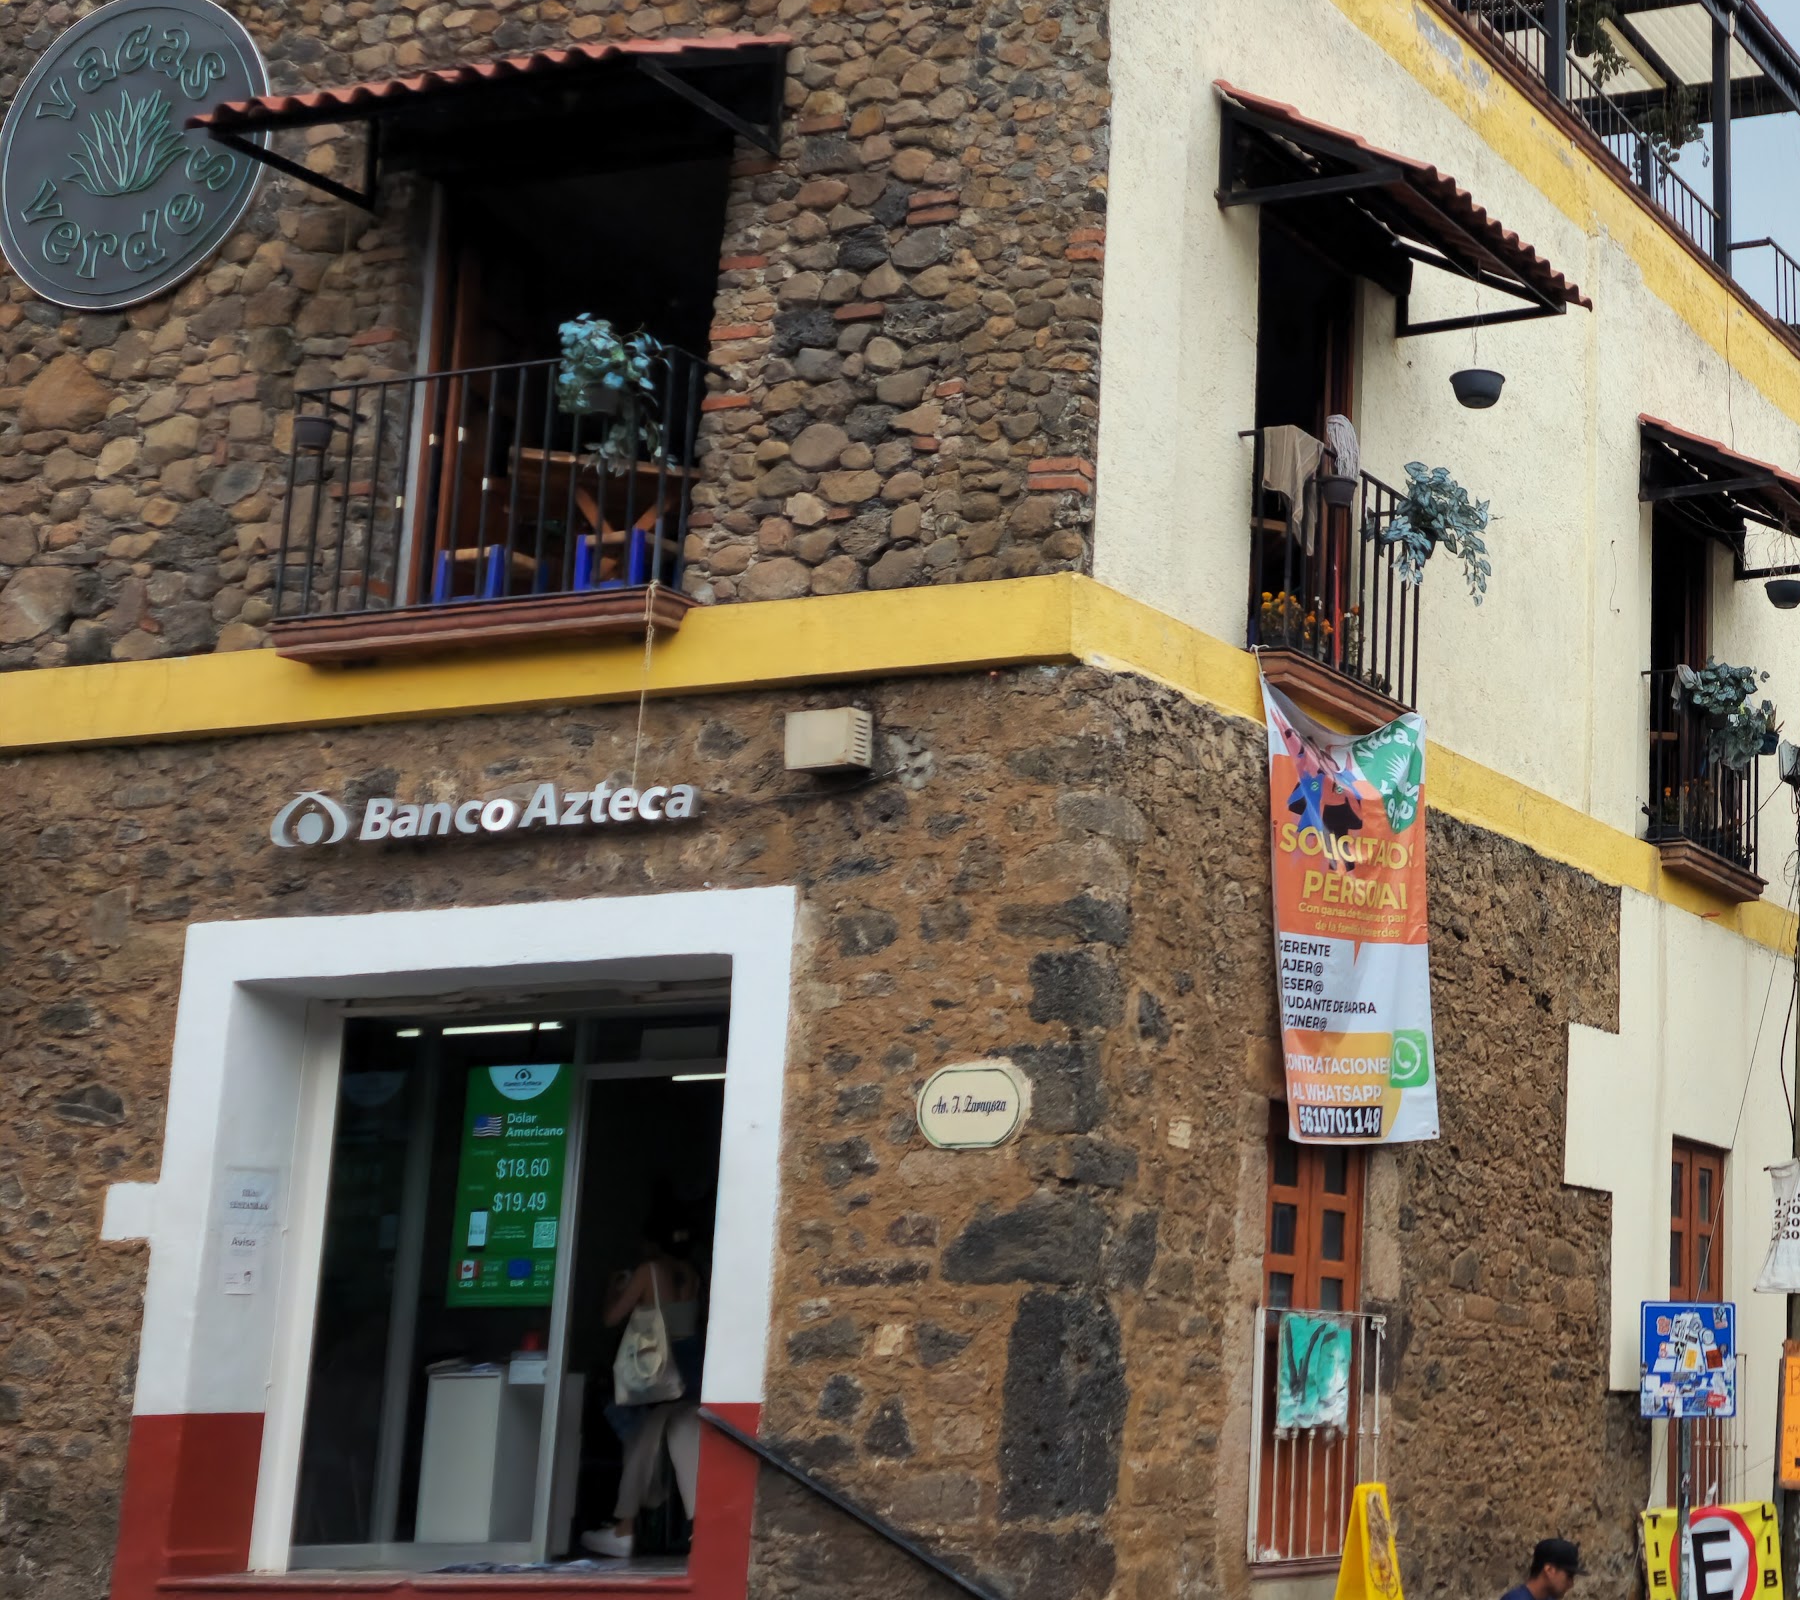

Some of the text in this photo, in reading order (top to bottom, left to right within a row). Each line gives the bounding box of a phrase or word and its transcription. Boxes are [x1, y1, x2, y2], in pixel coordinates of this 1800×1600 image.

[1357, 725, 1415, 760] Vaca
[359, 780, 700, 841] Banco Azteca
[1298, 902, 1320, 914] Con
[1282, 958, 1324, 976] AJER@
[1282, 977, 1324, 995] ESER@
[1293, 1082, 1381, 1102] AL WHATSAPP
[931, 1096, 949, 1114] Av.
[963, 1095, 1007, 1116] Zaragoza
[507, 1112, 538, 1124] Dólar
[1299, 1105, 1381, 1135] 5610701148
[505, 1126, 565, 1138] Americano
[495, 1157, 551, 1179] $18.60
[492, 1191, 548, 1213] $19.49
[231, 1237, 256, 1247] Aviso
